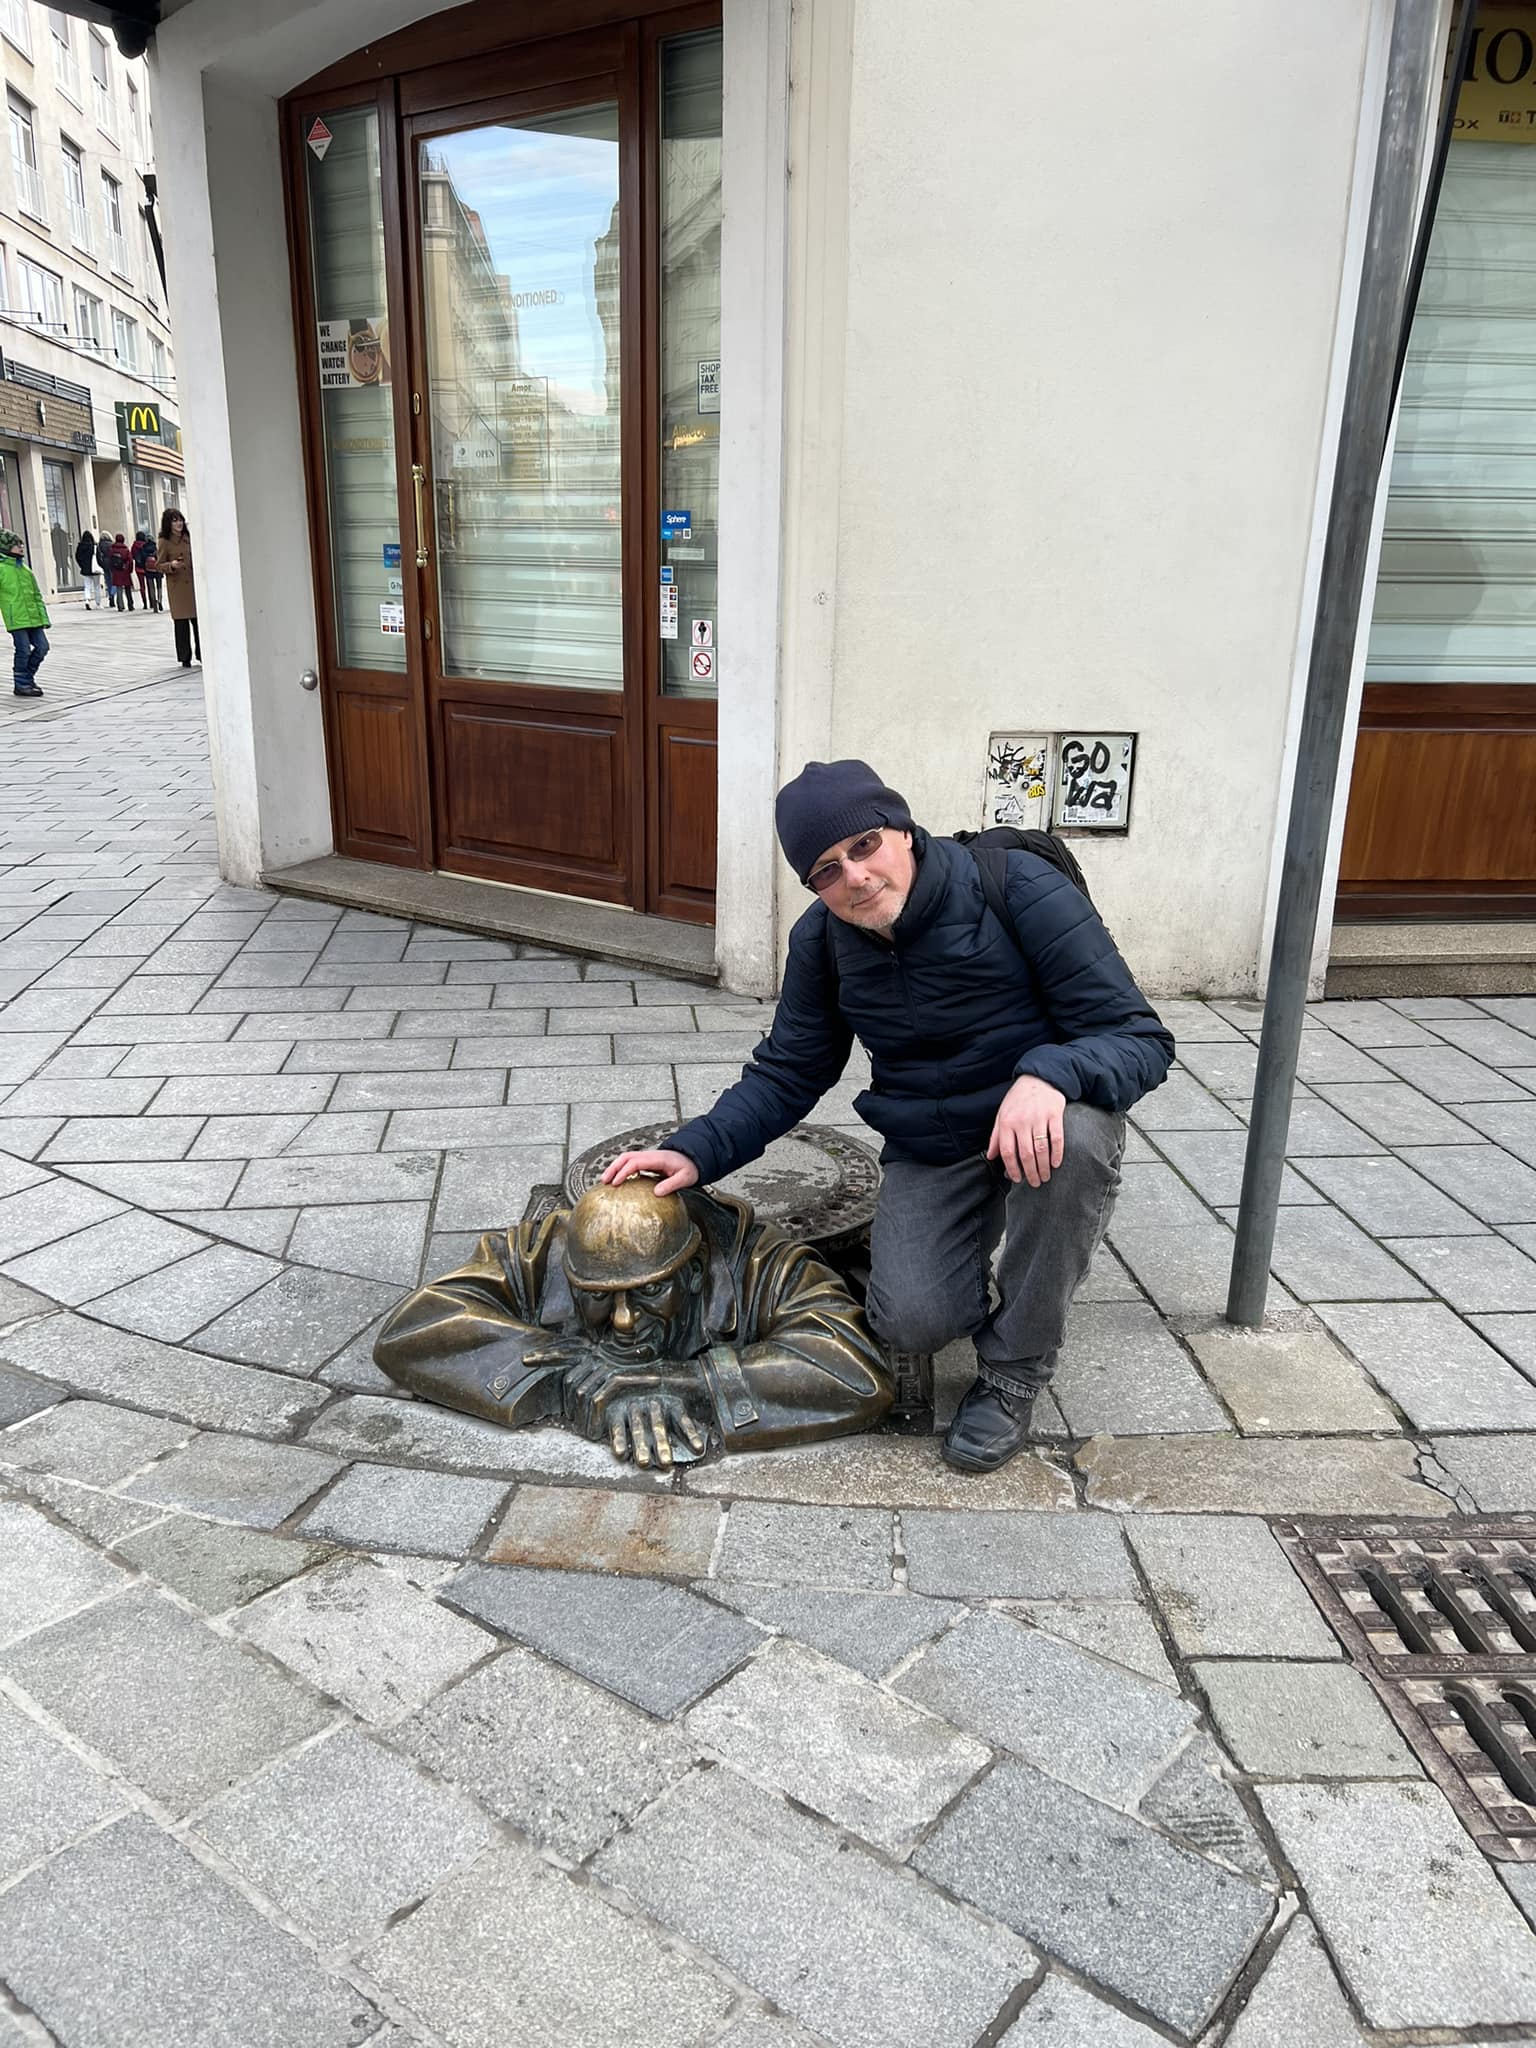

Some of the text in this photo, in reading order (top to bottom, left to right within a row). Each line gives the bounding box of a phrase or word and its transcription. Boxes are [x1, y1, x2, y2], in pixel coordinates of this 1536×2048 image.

[320, 325, 330, 336] WE
[321, 341, 347, 353] CHANGE
[322, 357, 345, 369] WATCH
[700, 364, 720, 373] SHOP
[323, 374, 350, 385] BATTERY
[700, 375, 715, 384] TAX
[700, 384, 719, 394] FREE
[476, 449, 495, 458] OPEN
[666, 514, 687, 524] Sphere
